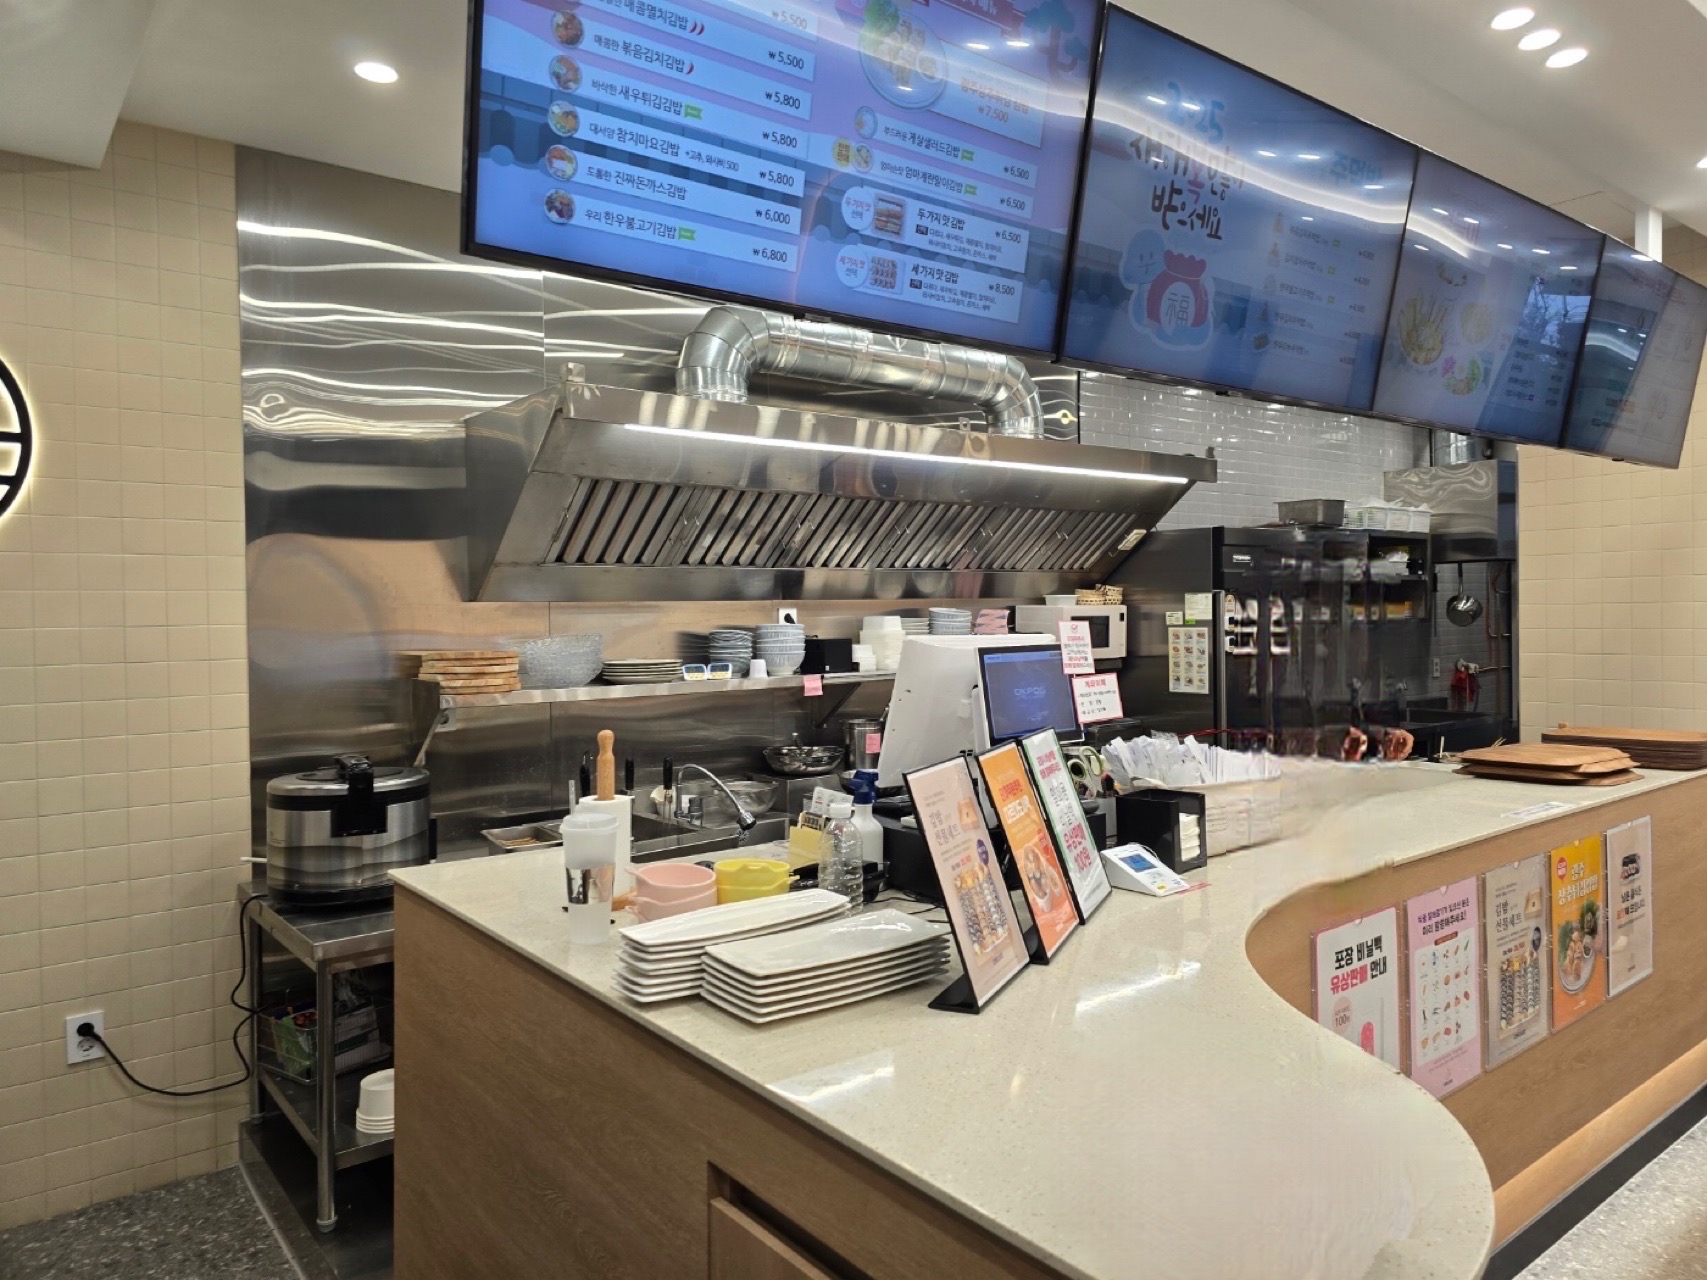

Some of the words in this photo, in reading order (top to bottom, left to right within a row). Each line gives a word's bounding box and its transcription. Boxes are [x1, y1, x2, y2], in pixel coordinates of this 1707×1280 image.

[621, 40, 685, 73] 볶음김치김밥
[619, 85, 683, 115] 새우튀김김밥
[616, 127, 680, 157] 참치마요김밥
[614, 170, 687, 200] 진짜돈까스김밥
[584, 209, 602, 223] 우리
[604, 211, 676, 240] 한우불고기김밥
[1334, 946, 1354, 970] 포장
[1356, 934, 1383, 963] 비닐백
[1330, 963, 1369, 995] 유상판매
[1369, 955, 1387, 980] 안내
